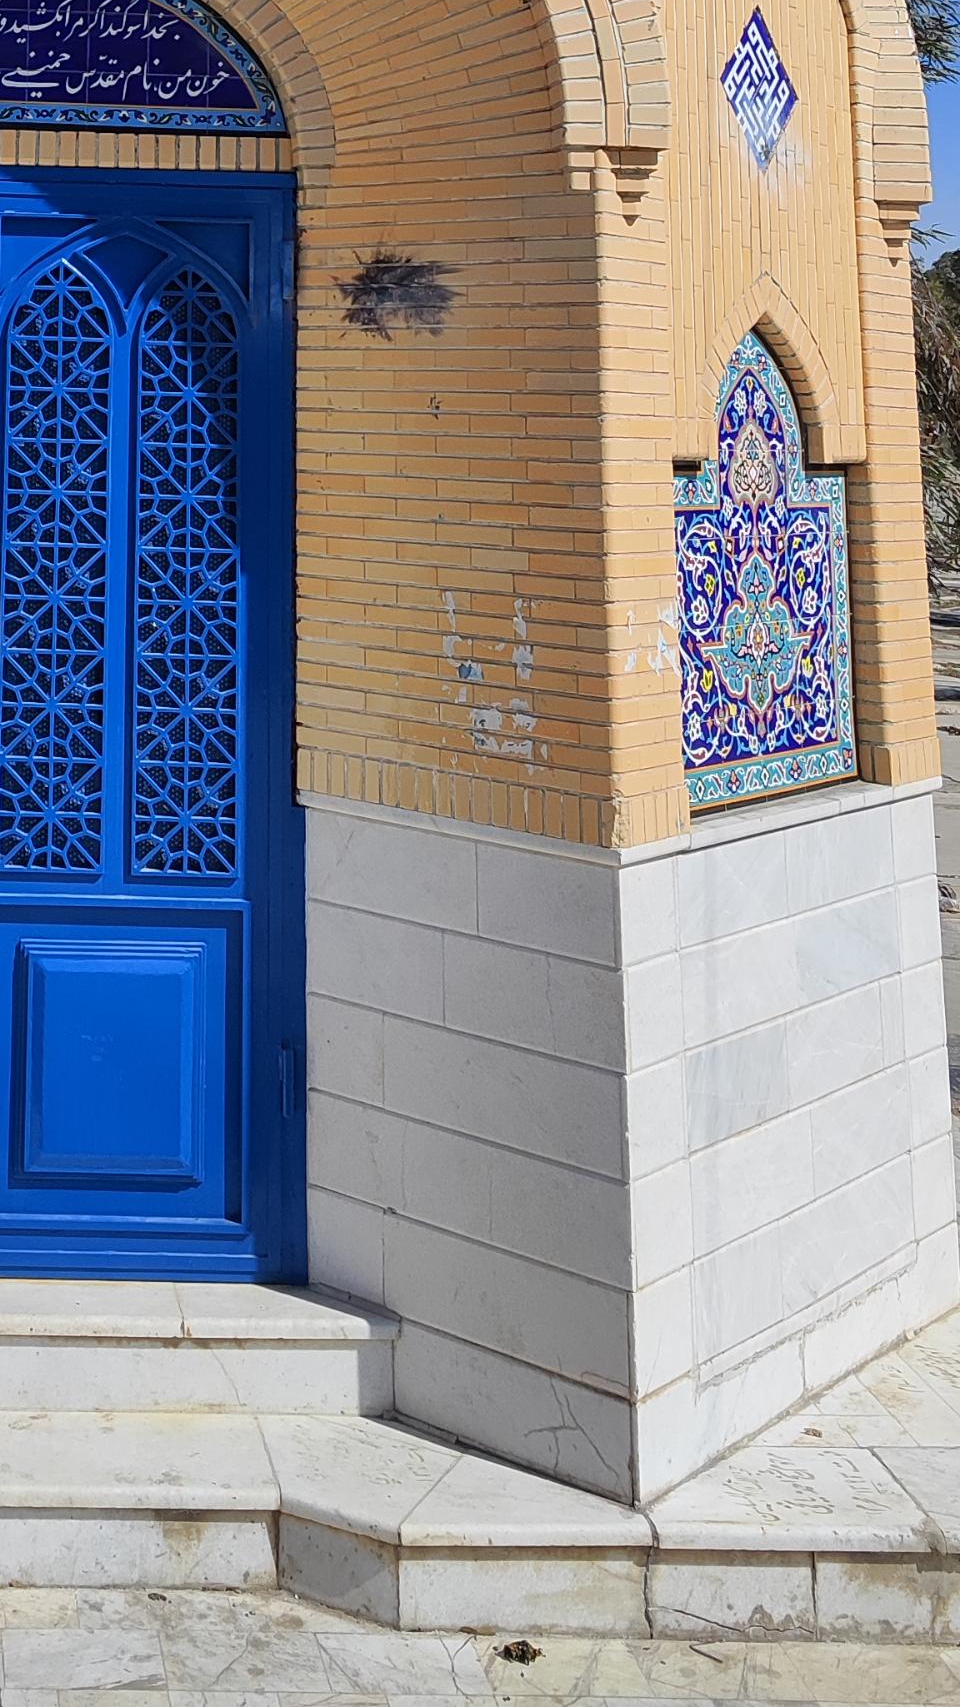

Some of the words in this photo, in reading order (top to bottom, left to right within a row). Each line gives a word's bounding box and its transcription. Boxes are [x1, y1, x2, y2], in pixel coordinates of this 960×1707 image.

[62, 5, 84, 42] مرا
[141, 9, 181, 41] بخدا
[2, 50, 71, 98] خمینی
[122, 58, 160, 102] نام
[186, 61, 230, 97] خون
